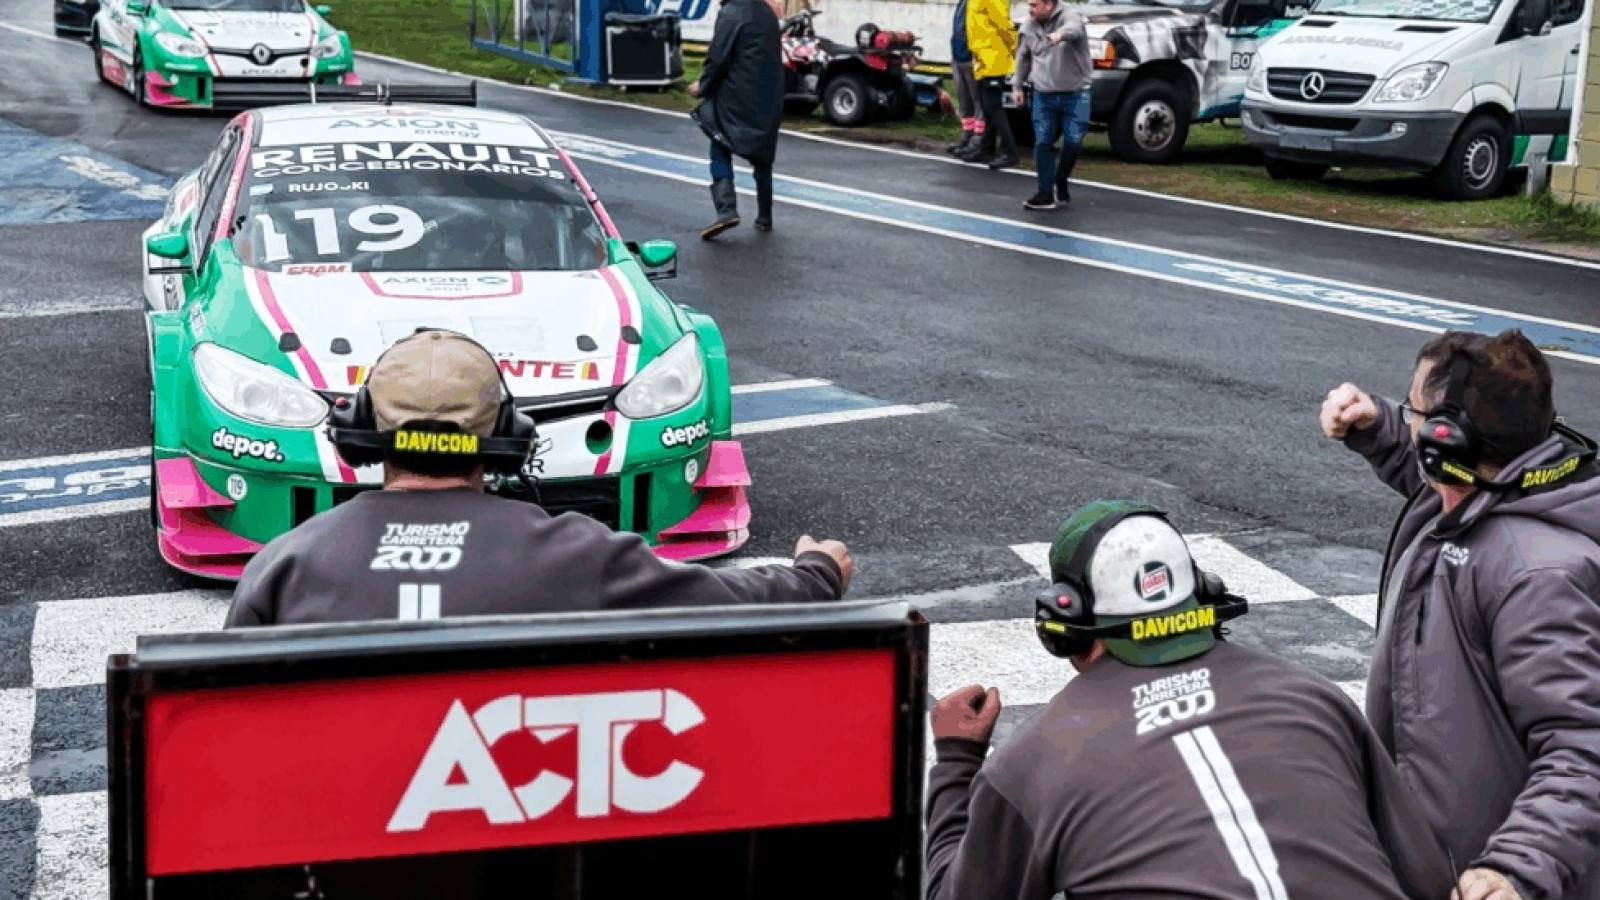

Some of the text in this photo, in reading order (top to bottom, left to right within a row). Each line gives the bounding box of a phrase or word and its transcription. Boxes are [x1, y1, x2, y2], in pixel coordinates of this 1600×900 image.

[1230, 52, 1254, 69] BO
[328, 118, 479, 130] AXION
[414, 129, 480, 138] energy
[251, 142, 559, 170] RENAULT
[253, 160, 565, 180] CONCESIONARIOS
[383, 276, 468, 284] AXION
[498, 359, 576, 379] NTE
[213, 427, 283, 461] depot.
[395, 431, 479, 453] DAVICOM
[386, 520, 470, 537] TURISMO
[380, 535, 465, 545] CARRETERA
[370, 545, 463, 570] 2000
[1131, 607, 1216, 641] DAVICOM
[1131, 668, 1210, 697] TURISMO
[1133, 680, 1211, 709] CARRETERA
[1135, 690, 1216, 736] 2000
[385, 688, 706, 832] ACTC
